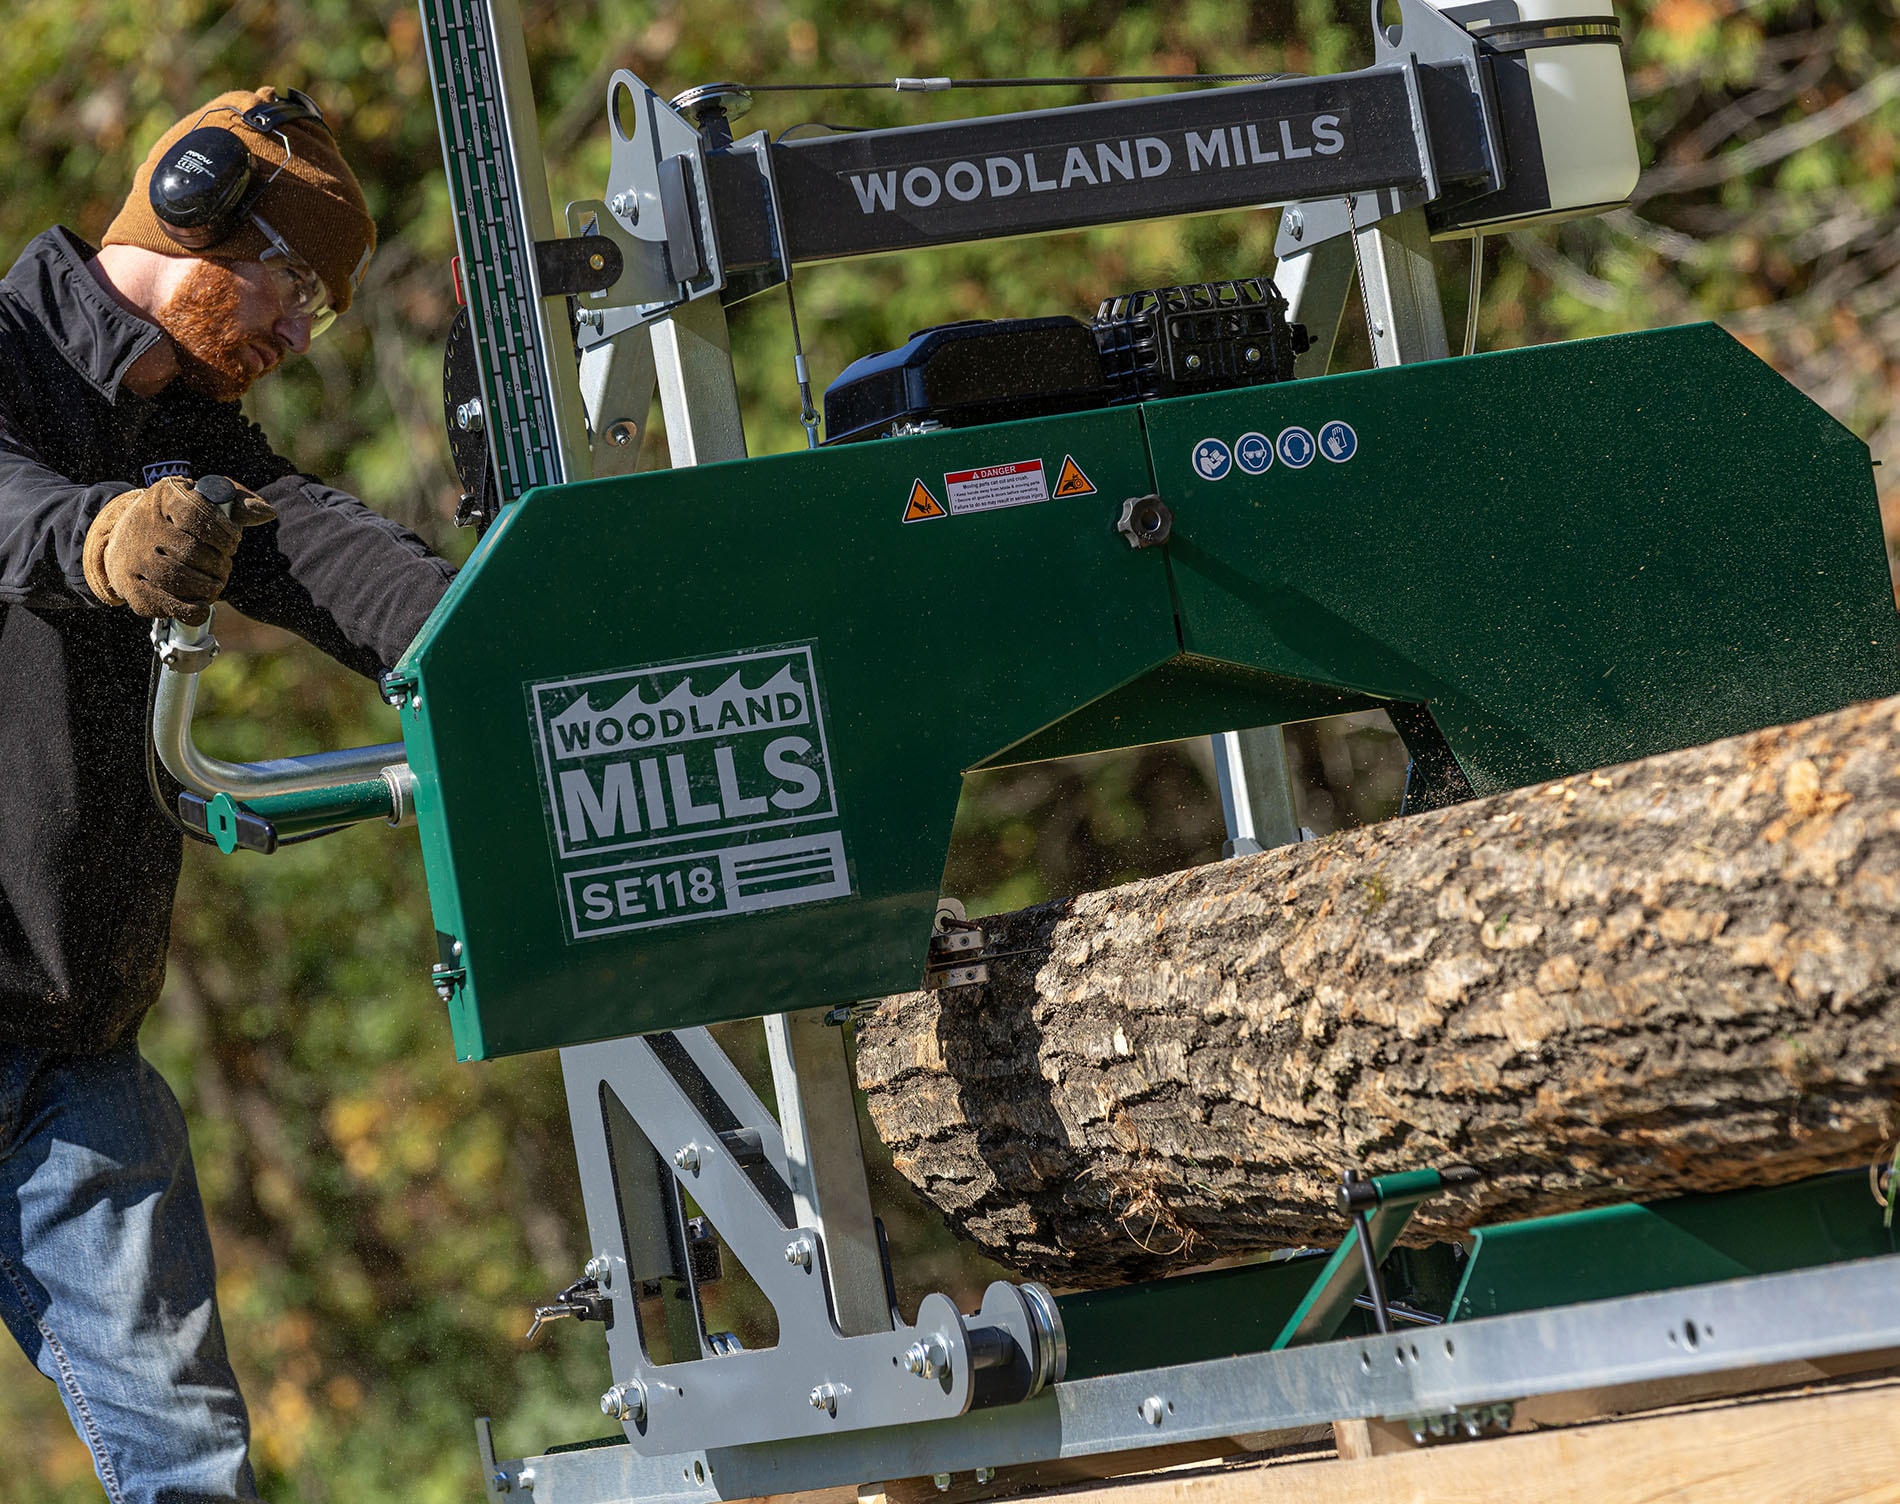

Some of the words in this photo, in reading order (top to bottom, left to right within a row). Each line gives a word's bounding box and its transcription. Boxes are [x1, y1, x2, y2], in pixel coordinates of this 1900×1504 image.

[462, 57, 468, 65] 2
[473, 122, 478, 130] 2
[450, 145, 455, 153] 4
[850, 136, 1173, 215] WOODLAND
[1185, 115, 1346, 172] MILLS
[483, 188, 488, 196] 2
[493, 253, 499, 261] 2
[470, 272, 476, 280] 4
[504, 318, 510, 326] 2
[515, 384, 520, 392] 2
[526, 448, 532, 457] 2
[980, 466, 1017, 478] DANGER
[962, 482, 978, 490] Moving
[556, 691, 803, 752] WOODLAND
[559, 736, 821, 843] MILLS
[582, 867, 716, 921] SE118
